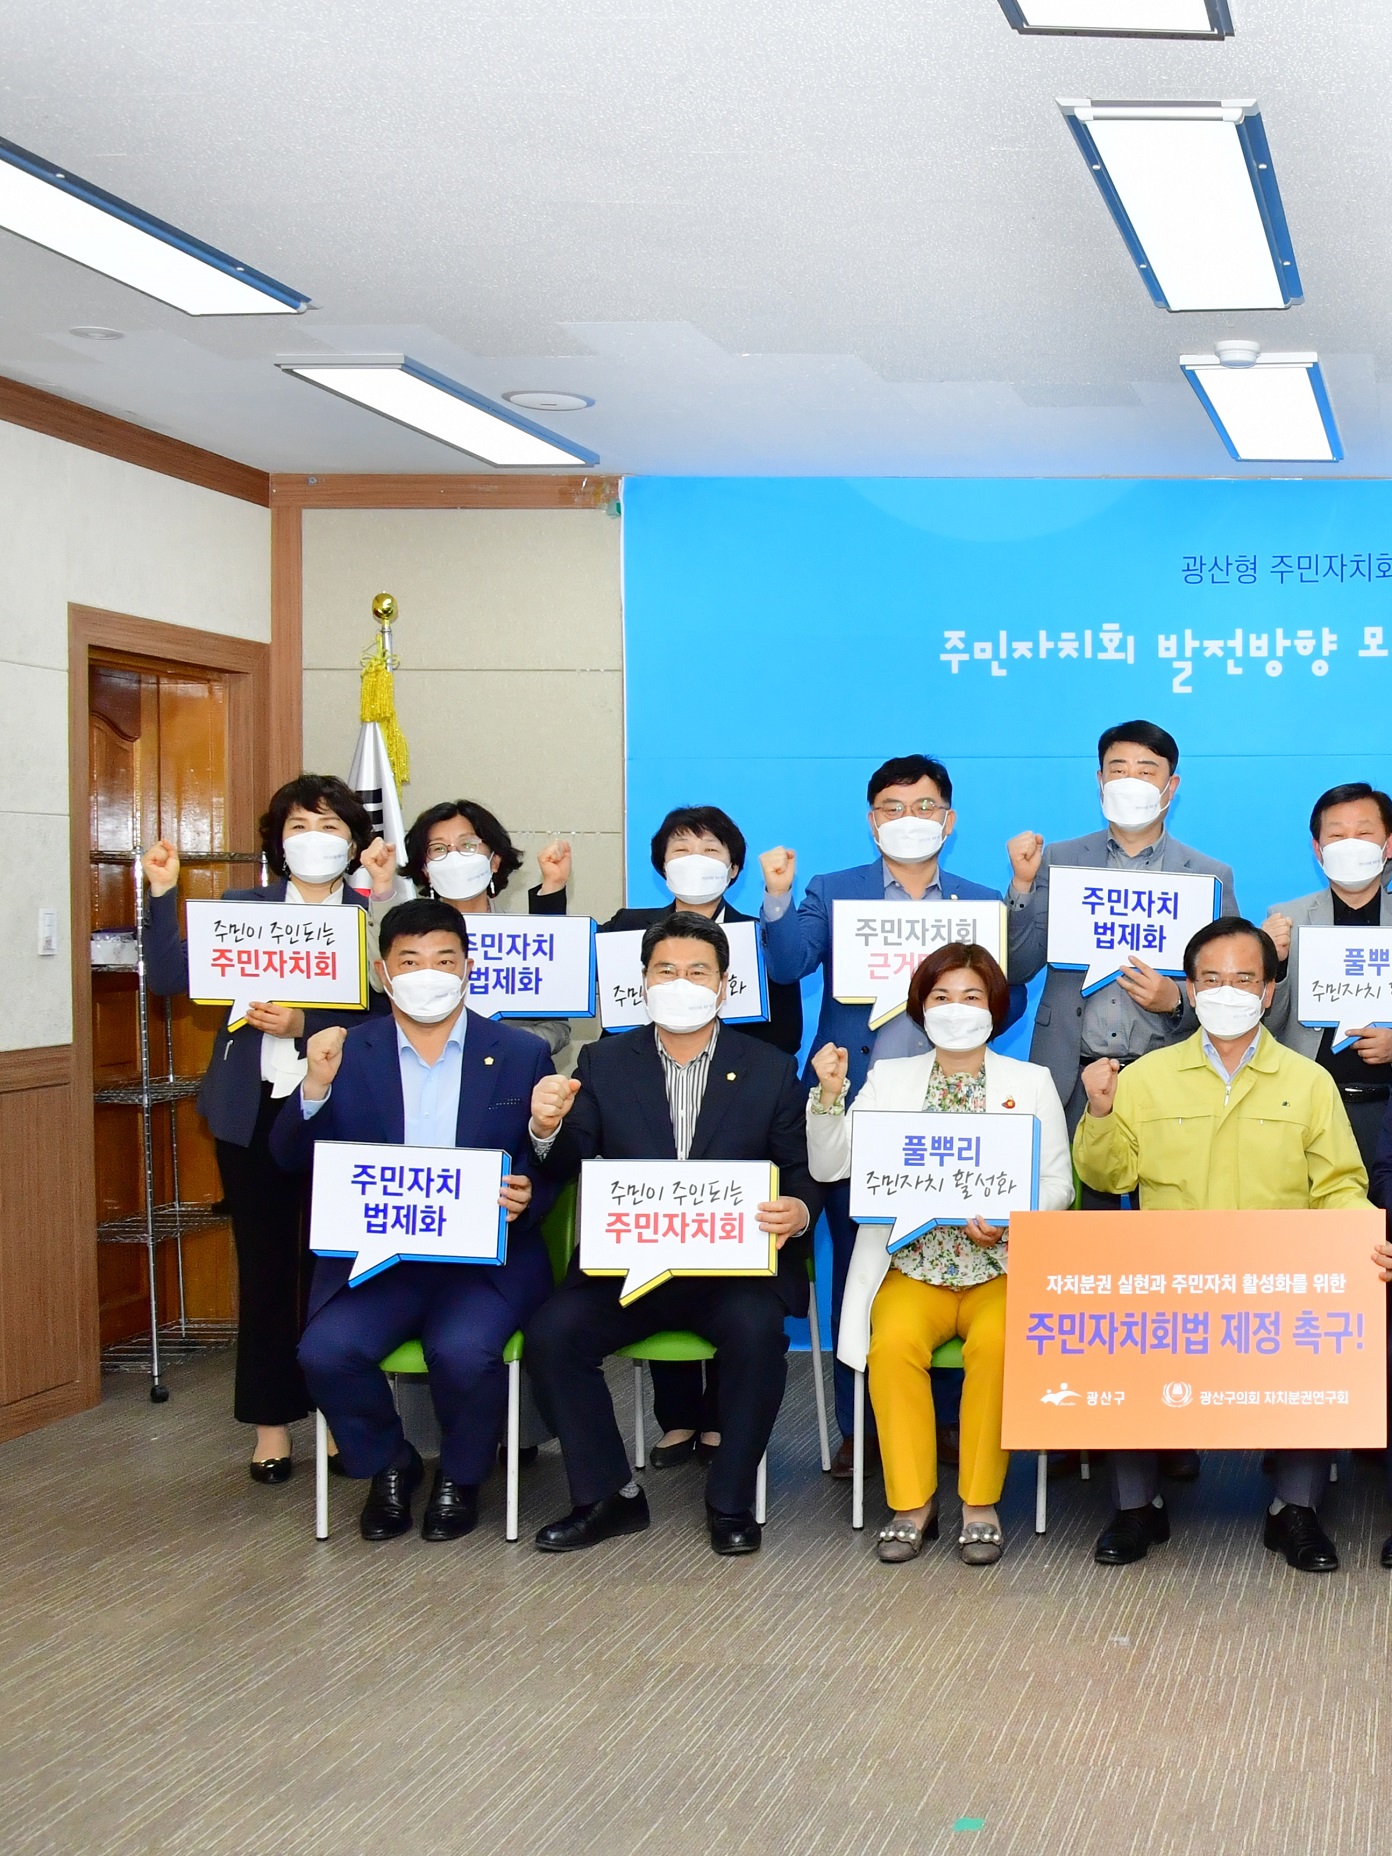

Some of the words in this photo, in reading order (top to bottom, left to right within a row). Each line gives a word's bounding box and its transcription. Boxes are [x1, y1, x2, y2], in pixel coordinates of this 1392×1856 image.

[1181, 553, 1258, 585] 광산형
[940, 623, 1134, 676] 주민자치회
[1158, 627, 1337, 693] 발전방향
[1082, 887, 1178, 920] 주민자치
[214, 920, 262, 943] 주민이
[270, 921, 336, 946] 주인되는
[855, 918, 977, 946] 주민자치회
[1094, 921, 1167, 953] 법제화
[211, 949, 337, 980] 주민자치회
[867, 952, 931, 980] 근거
[468, 966, 543, 995] 법제화
[1312, 980, 1381, 1002] 주민자치
[902, 1135, 981, 1167] 풀뿌리
[351, 1164, 461, 1200] 주민자치
[611, 1180, 664, 1206] 주민이
[673, 1180, 743, 1206] 주인되는
[866, 1171, 944, 1196] 주민자치
[953, 1169, 1017, 1200] 활성화
[364, 1203, 447, 1237] 법제화
[605, 1212, 744, 1244] 주민자치회
[1046, 1275, 1112, 1294] 자치분권
[1117, 1274, 1166, 1294] 실현과
[1171, 1274, 1237, 1294] 주민자치
[1241, 1273, 1308, 1293] 활성화를
[1312, 1273, 1347, 1294] 위한
[1025, 1311, 1209, 1356] 주민자치회법
[1220, 1311, 1281, 1355] 제정
[1292, 1310, 1364, 1354] 촉구!
[1086, 1391, 1126, 1406] 광산구
[1199, 1390, 1261, 1406] 광산구의회
[1264, 1390, 1349, 1405] 자치분권연구회
